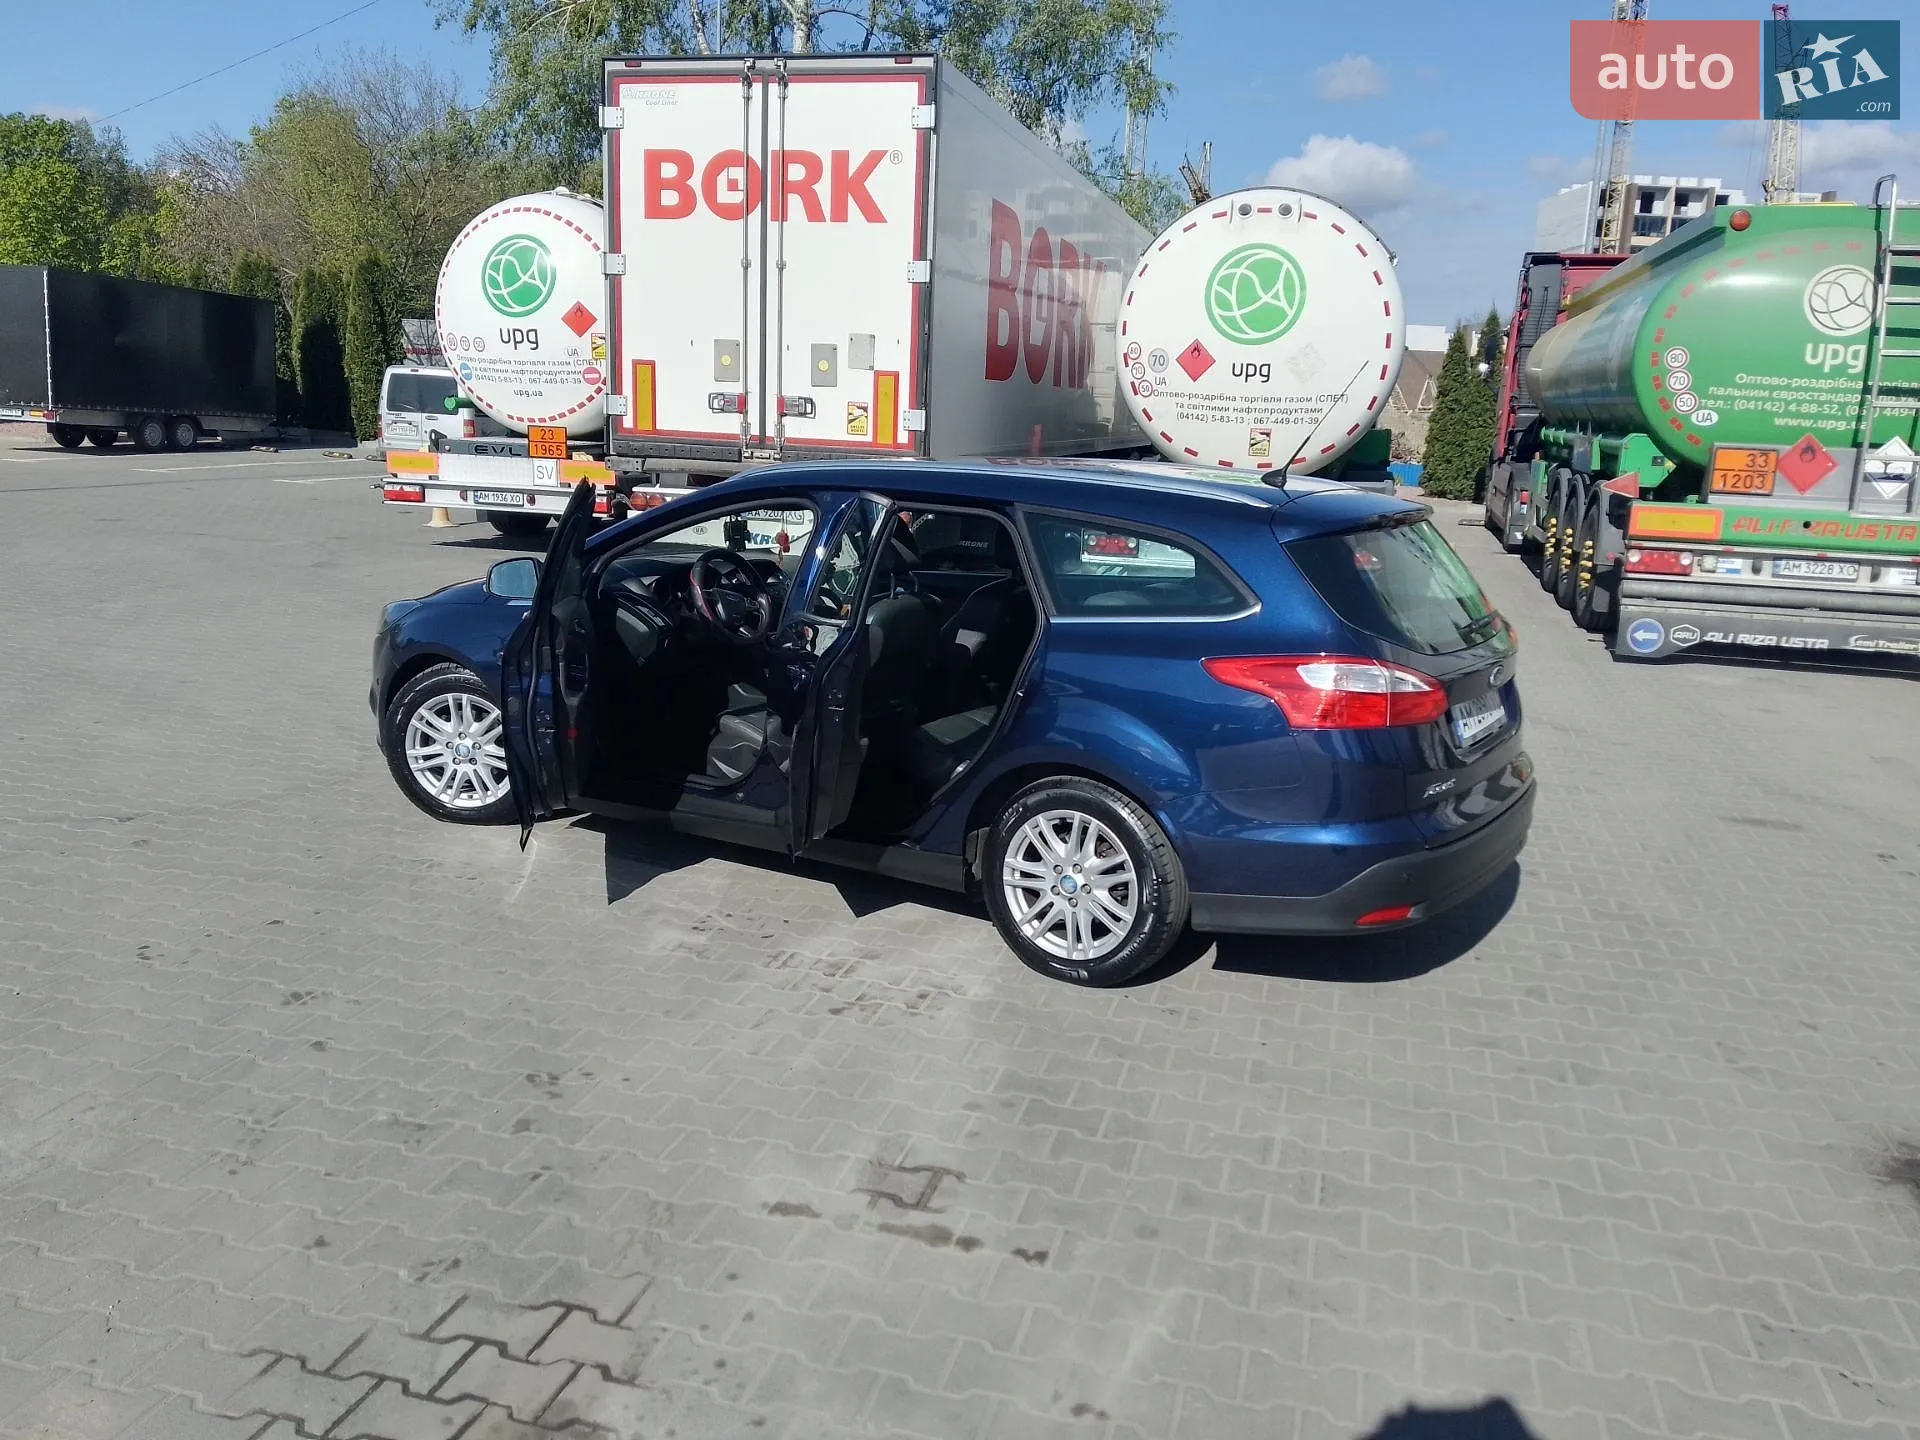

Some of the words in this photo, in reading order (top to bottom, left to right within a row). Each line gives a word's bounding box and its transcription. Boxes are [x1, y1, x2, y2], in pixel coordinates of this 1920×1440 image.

[500, 327, 539, 350] upg
[566, 348, 579, 356] UA
[1670, 353, 1684, 363] 80
[1152, 354, 1166, 367] 70
[1804, 343, 1867, 374] upg
[1232, 362, 1271, 383] upg
[1154, 376, 1166, 386] UA
[1672, 376, 1686, 386] 70
[1736, 374, 1864, 389] Оптово-роздрібна
[1141, 384, 1150, 392] 50
[1708, 386, 1769, 398] пальним
[1152, 390, 1236, 402] Оптово-роздрібна
[1240, 395, 1282, 404] торгівля
[1679, 398, 1692, 408] 50
[1186, 402, 1230, 412] світлими
[1232, 406, 1322, 417] нафтопродуктами
[1734, 399, 1784, 413] (04142)
[1176, 412, 1208, 422] (04142)
[1212, 415, 1244, 424] 5-83-13
[1254, 416, 1319, 424] 067-449-01-39
[1696, 412, 1713, 423] UA
[540, 428, 554, 440] 23
[474, 444, 522, 456] EVL
[534, 444, 562, 456] 1965
[1745, 453, 1770, 468] 33
[536, 466, 554, 480] SV
[1720, 474, 1766, 489] 1203
[478, 494, 490, 502] AM
[491, 494, 508, 502] 1936
[510, 494, 520, 502] XO
[1783, 562, 1800, 572] AM
[1804, 563, 1834, 575] 3228
[1838, 564, 1854, 576] XO
[1673, 632, 1698, 640] ARU
[1780, 636, 1829, 649] USTA
